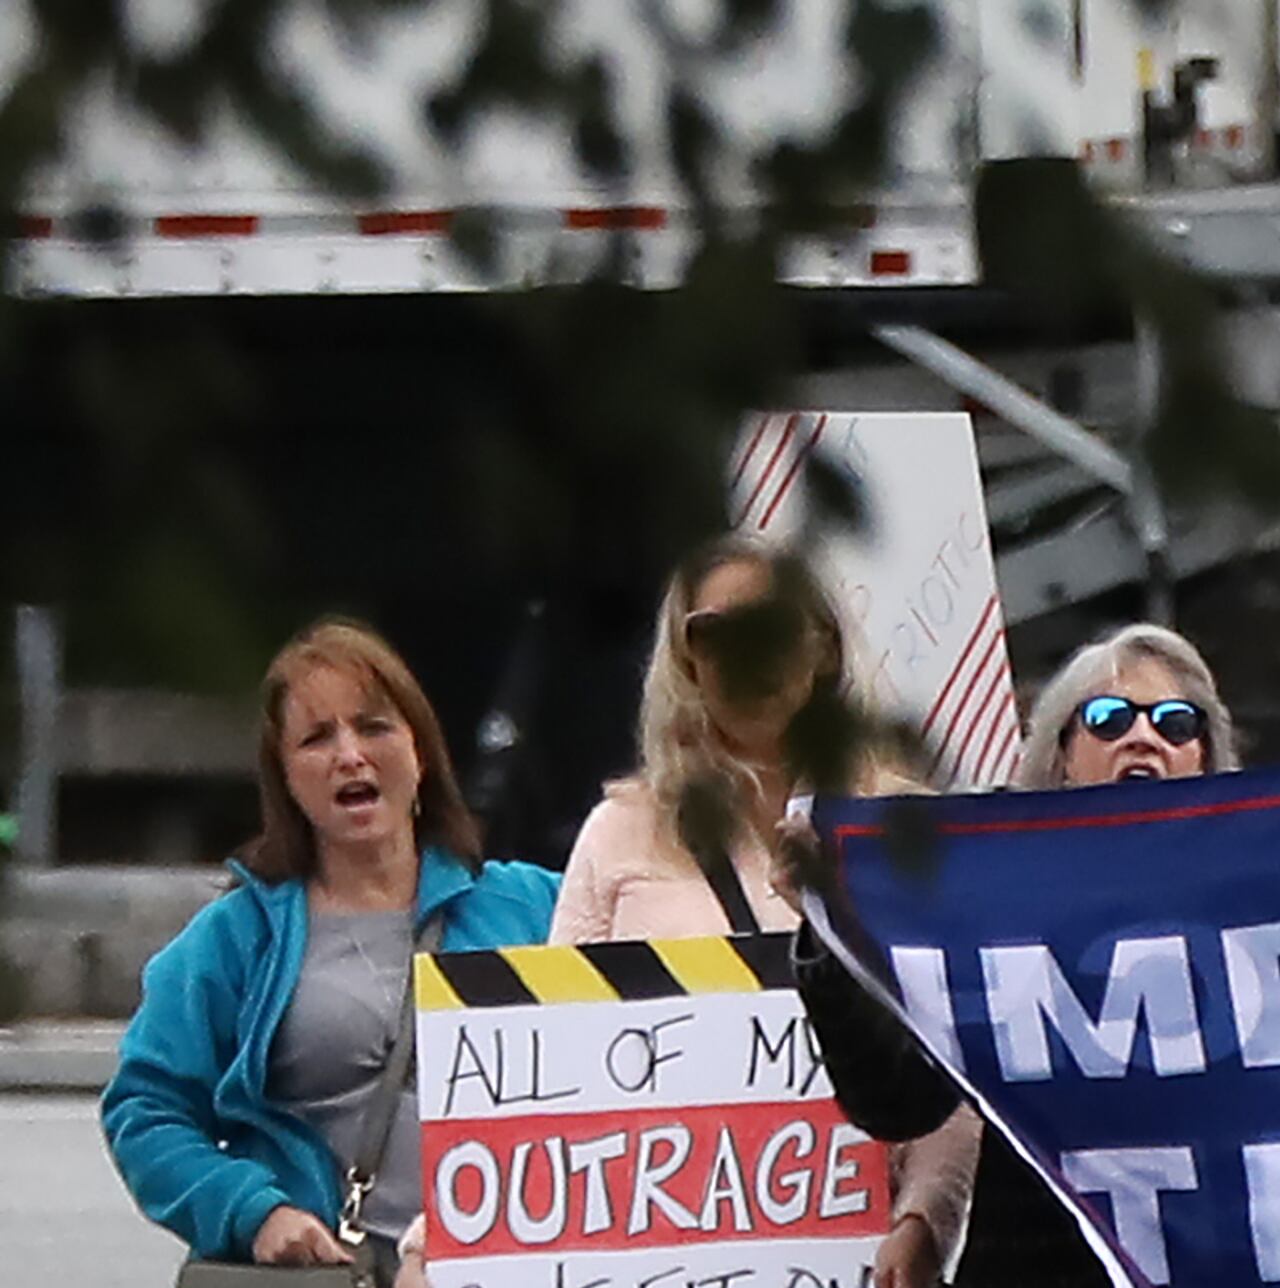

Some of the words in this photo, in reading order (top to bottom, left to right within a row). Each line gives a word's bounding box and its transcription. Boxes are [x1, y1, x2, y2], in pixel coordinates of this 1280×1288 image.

[441, 1025, 582, 1115] ALL
[605, 1014, 695, 1094] OF
[433, 1120, 875, 1246] OUTRAGE
